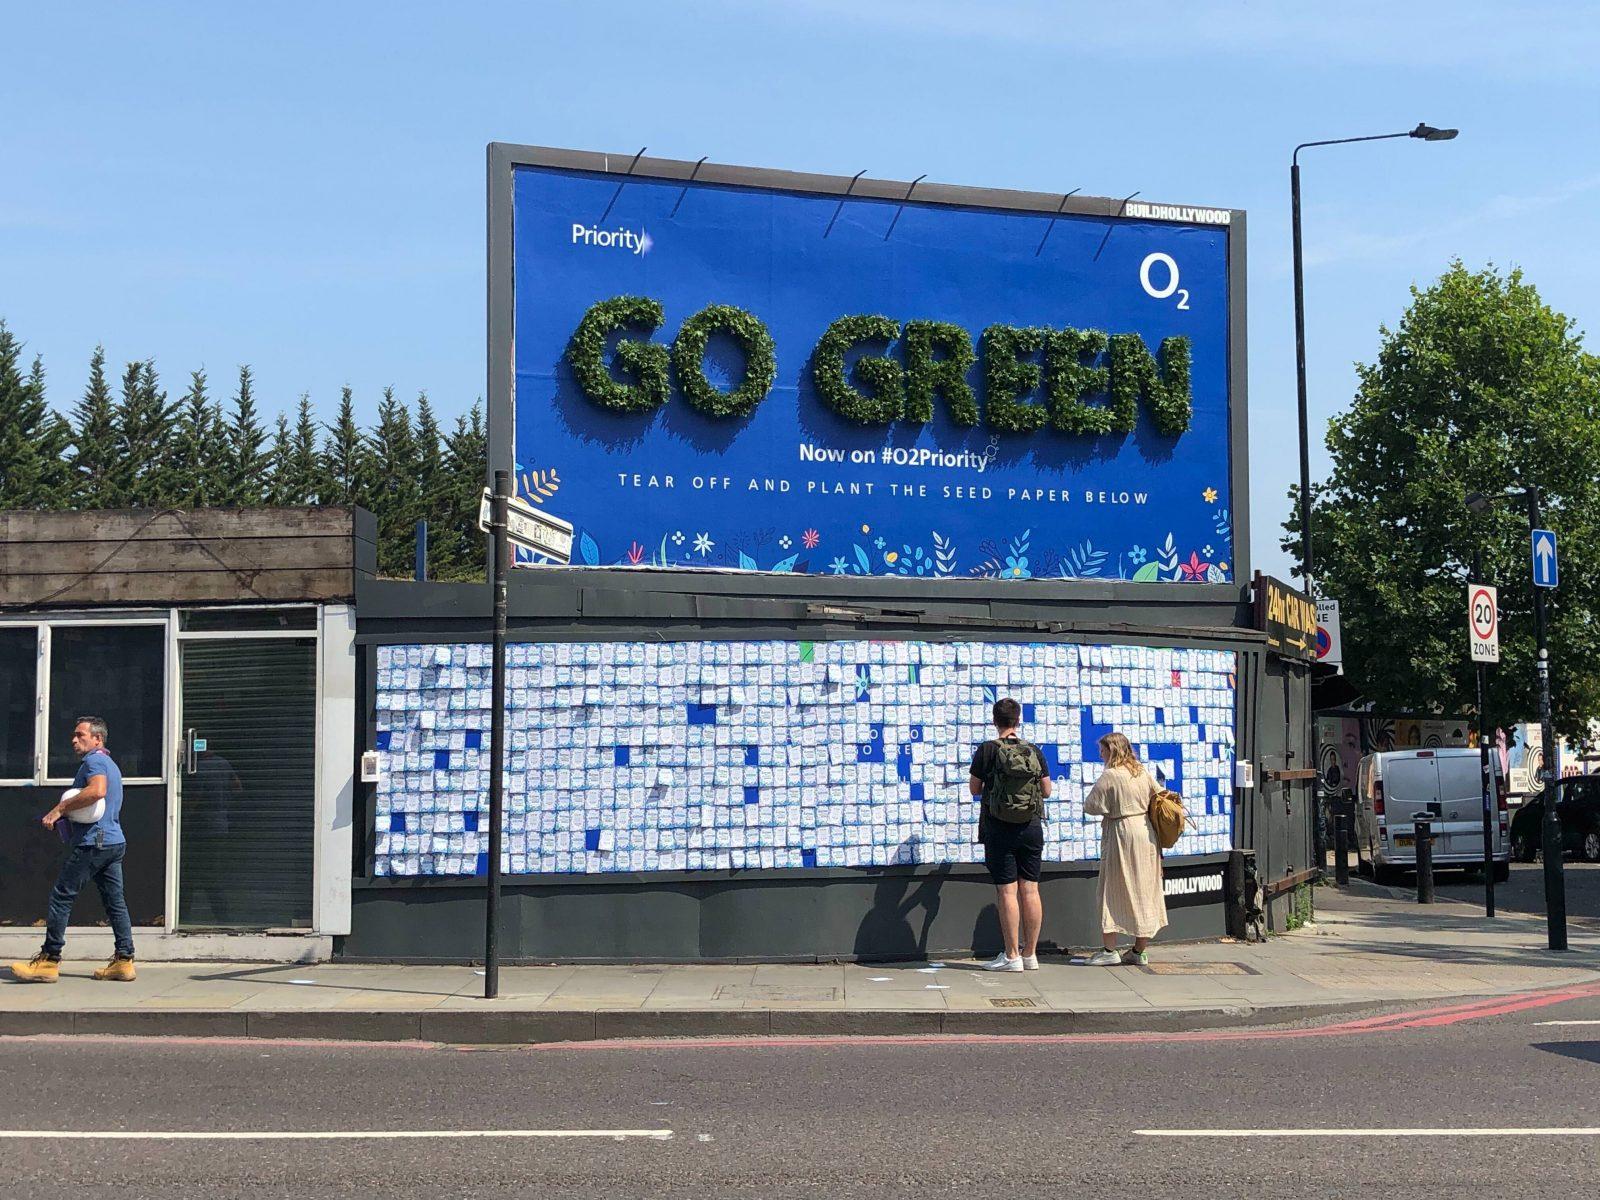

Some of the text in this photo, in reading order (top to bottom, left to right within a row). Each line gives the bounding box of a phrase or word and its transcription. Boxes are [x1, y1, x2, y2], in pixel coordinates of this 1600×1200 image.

[1125, 202, 1232, 224] BUILDHOLLYWOOD
[572, 223, 644, 255] Priority
[565, 295, 1193, 436] GO GREEN
[799, 443, 988, 473] Now on #O2Priority
[618, 473, 1148, 505] TEAR OFF AND PLANT THE SEED PAPER BELOW
[1286, 592, 1301, 631] CAR
[1299, 599, 1316, 636] WAS
[1475, 603, 1492, 625] 20
[1473, 642, 1496, 656] ZONE
